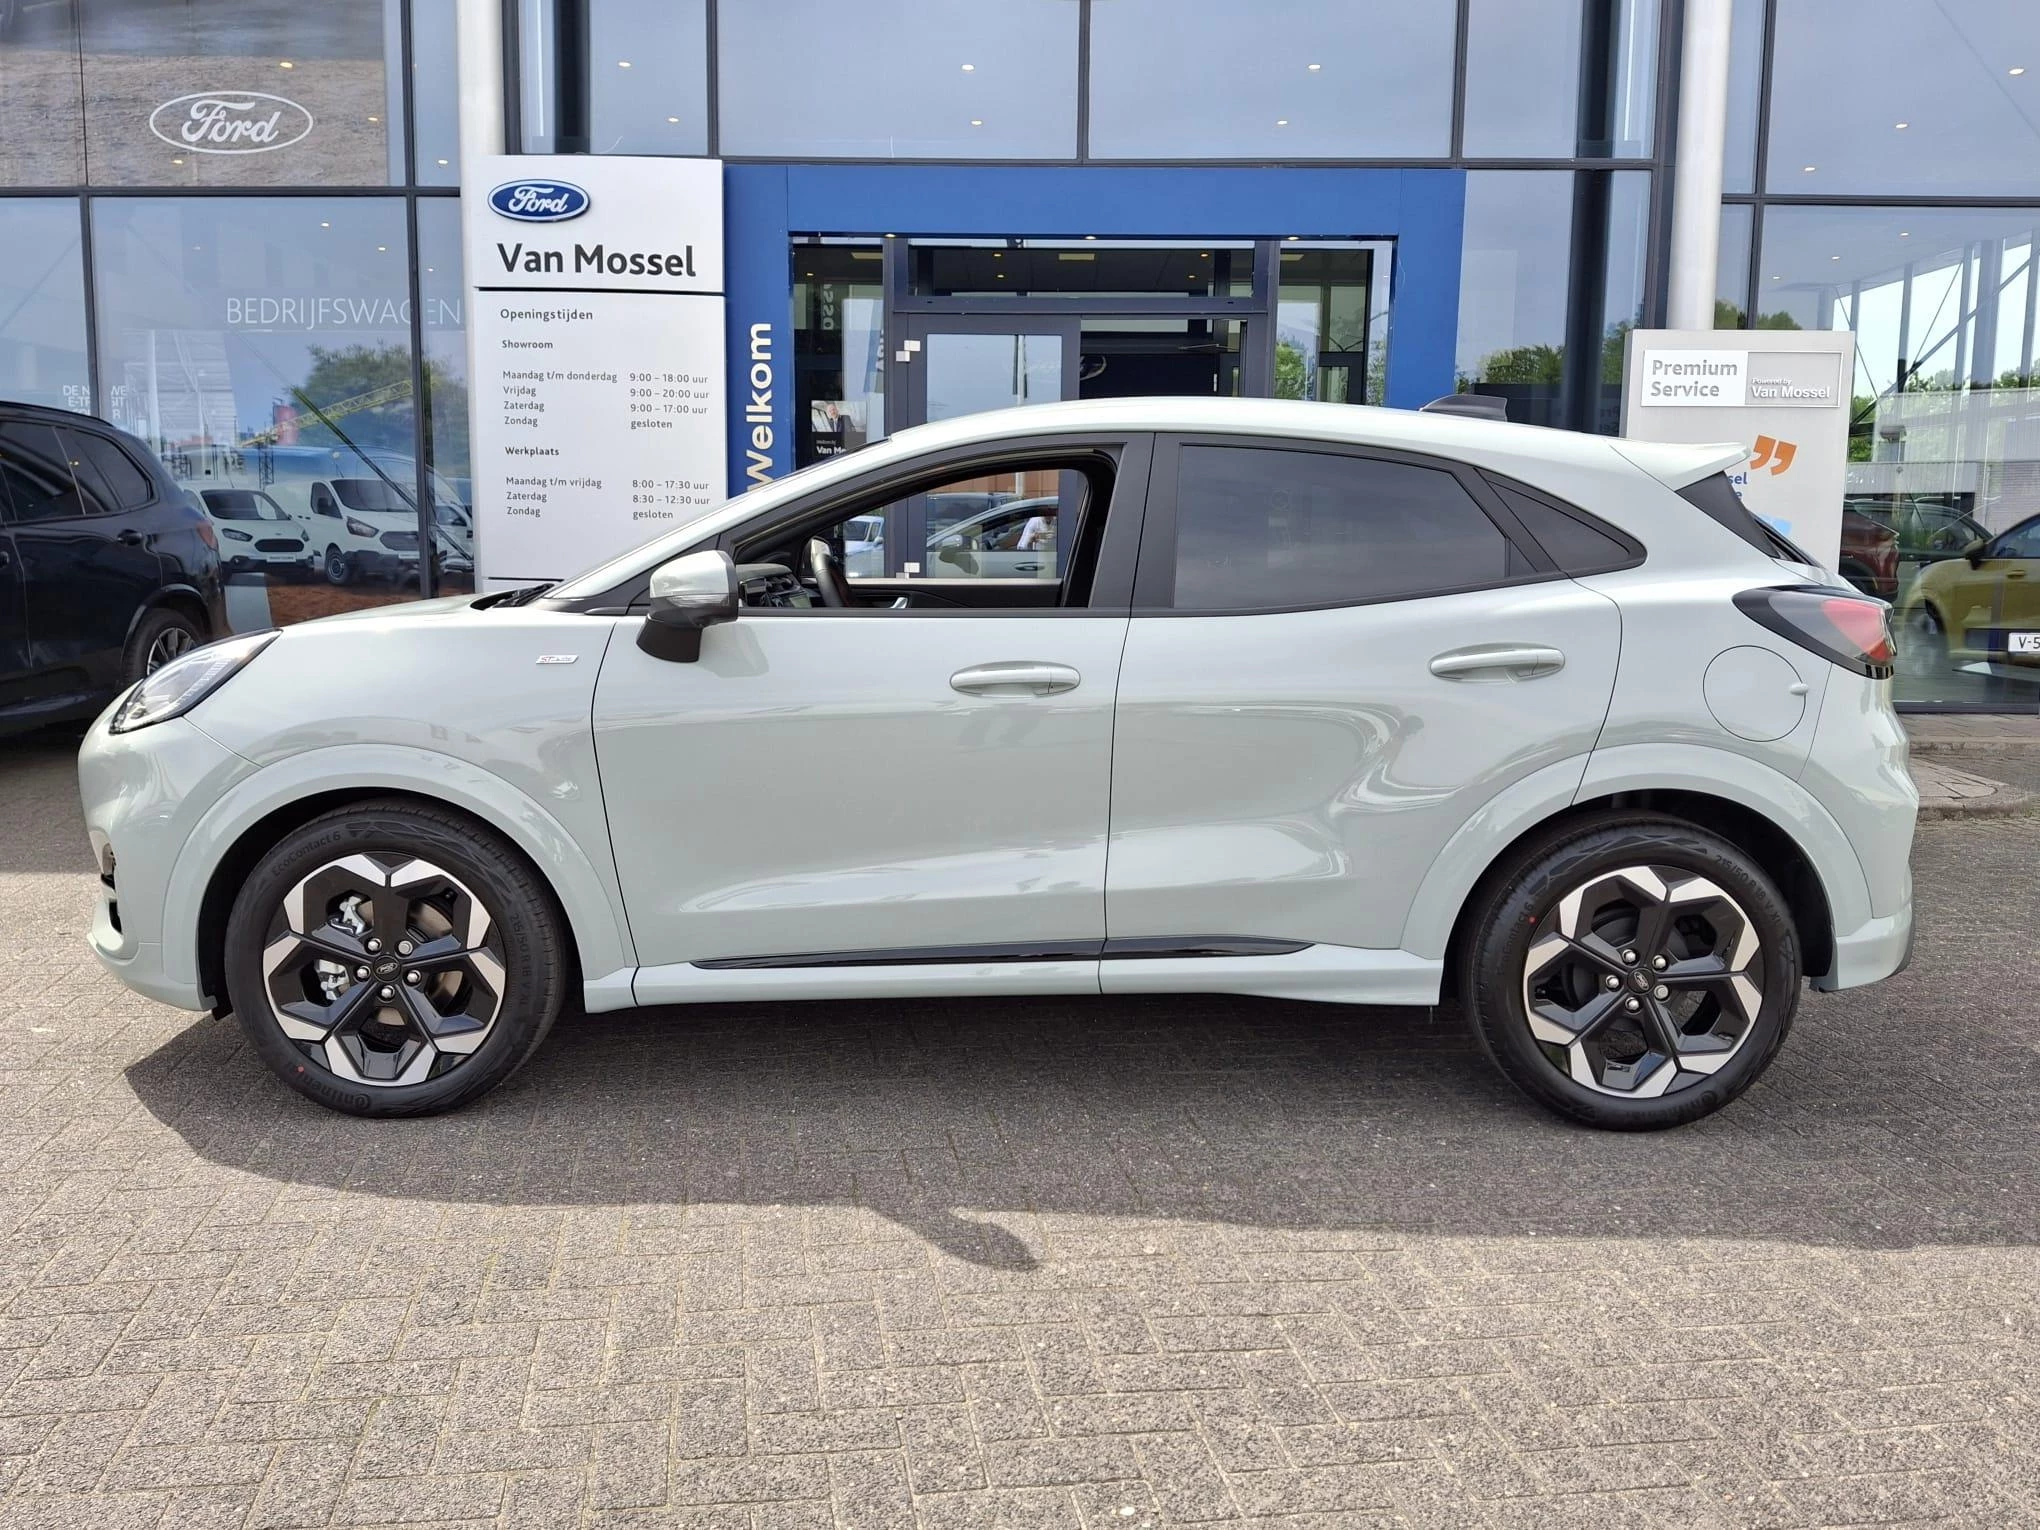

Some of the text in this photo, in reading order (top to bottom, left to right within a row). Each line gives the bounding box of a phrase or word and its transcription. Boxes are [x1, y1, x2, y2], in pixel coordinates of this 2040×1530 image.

[181, 99, 281, 143] Ford
[508, 186, 569, 213] Ford
[496, 242, 697, 278] Van Mossel
[500, 308, 593, 323] Openingstijden
[501, 339, 554, 349] Showroom
[1652, 359, 1738, 376] Premium
[502, 370, 545, 382] Maandag
[546, 370, 565, 381] t/m
[566, 370, 618, 384] donderdag
[629, 372, 652, 382] 9:00
[662, 373, 690, 384] 18:00
[692, 376, 708, 384] uur
[503, 385, 537, 398] Vrijdag
[629, 387, 652, 398] 9:00
[662, 388, 691, 399] 20:00
[1650, 381, 1720, 397] Service
[1751, 386, 1830, 398] Van Mossel
[503, 400, 545, 413] Zaterdag
[630, 403, 653, 413] 9:00
[663, 404, 690, 414] 17:00
[746, 323, 773, 492] Welkom
[504, 415, 673, 430] Zondag gesloten
[504, 446, 560, 458] Werkplaats
[505, 476, 548, 488] Maandag
[549, 477, 567, 486] t/m
[569, 477, 602, 490] vrijdag
[632, 479, 654, 489] 8:00
[664, 480, 691, 490] 17:30
[506, 491, 547, 504] Zaterdag
[632, 494, 655, 504] 8:30
[664, 495, 692, 505] 12:30
[694, 497, 710, 505] uur
[506, 506, 674, 521] Zondag gesloten
